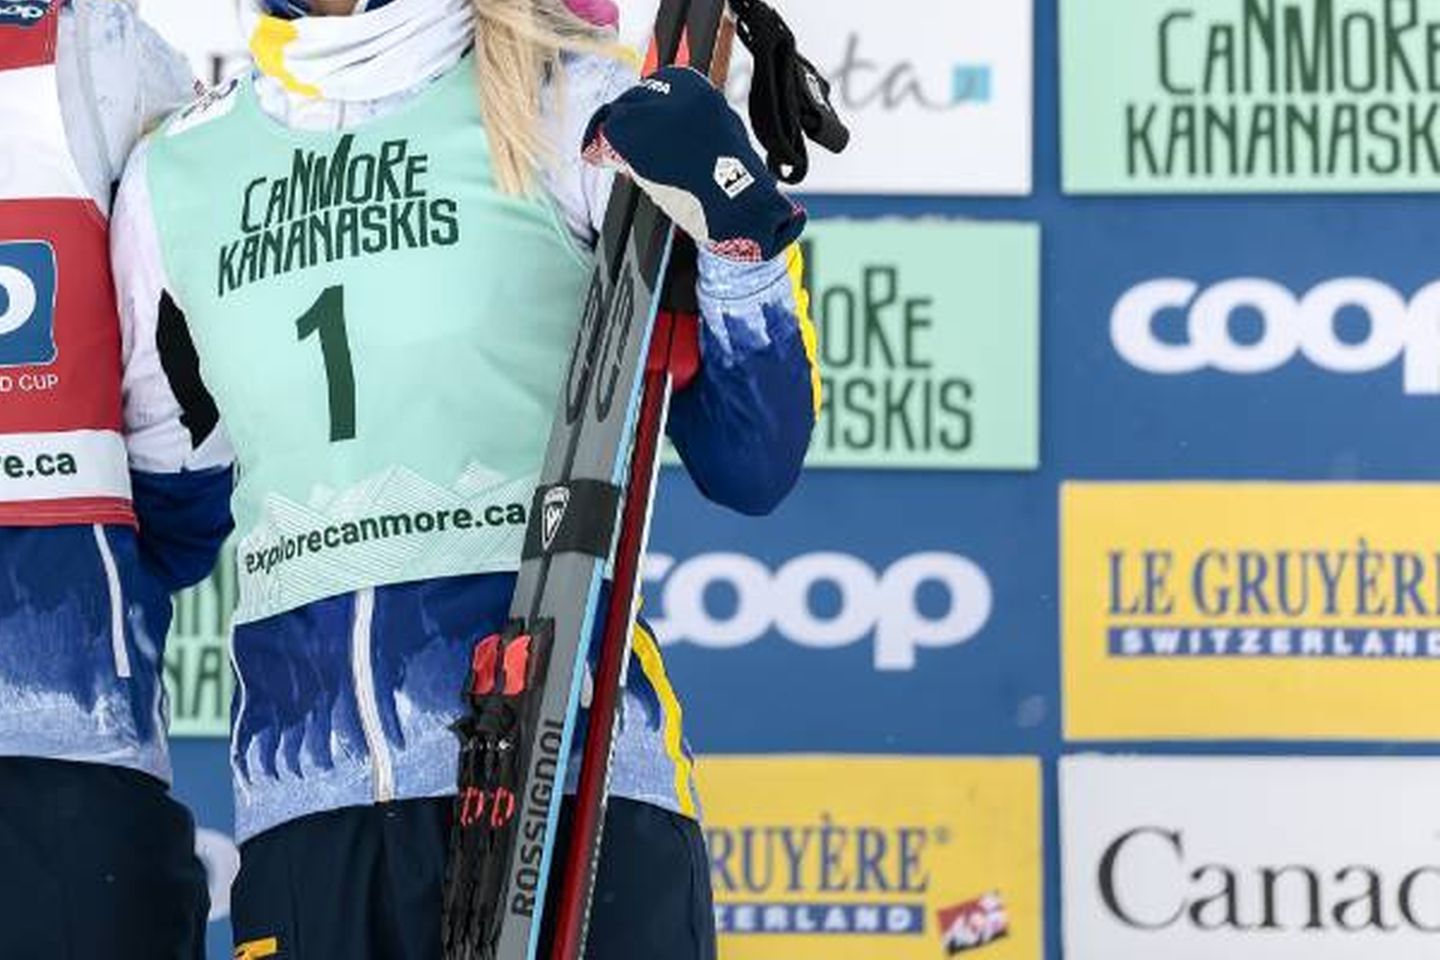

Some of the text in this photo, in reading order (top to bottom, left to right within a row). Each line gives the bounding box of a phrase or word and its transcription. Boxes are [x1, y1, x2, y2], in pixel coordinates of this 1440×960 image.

[1126, 102, 1440, 177] KANANASK
[217, 197, 460, 298] KANANASKIS
[18, 373, 59, 392] CUP
[295, 283, 357, 442] 1
[244, 499, 527, 576] explorecanmore.ca
[1107, 536, 1440, 618] LE GRUYÈR
